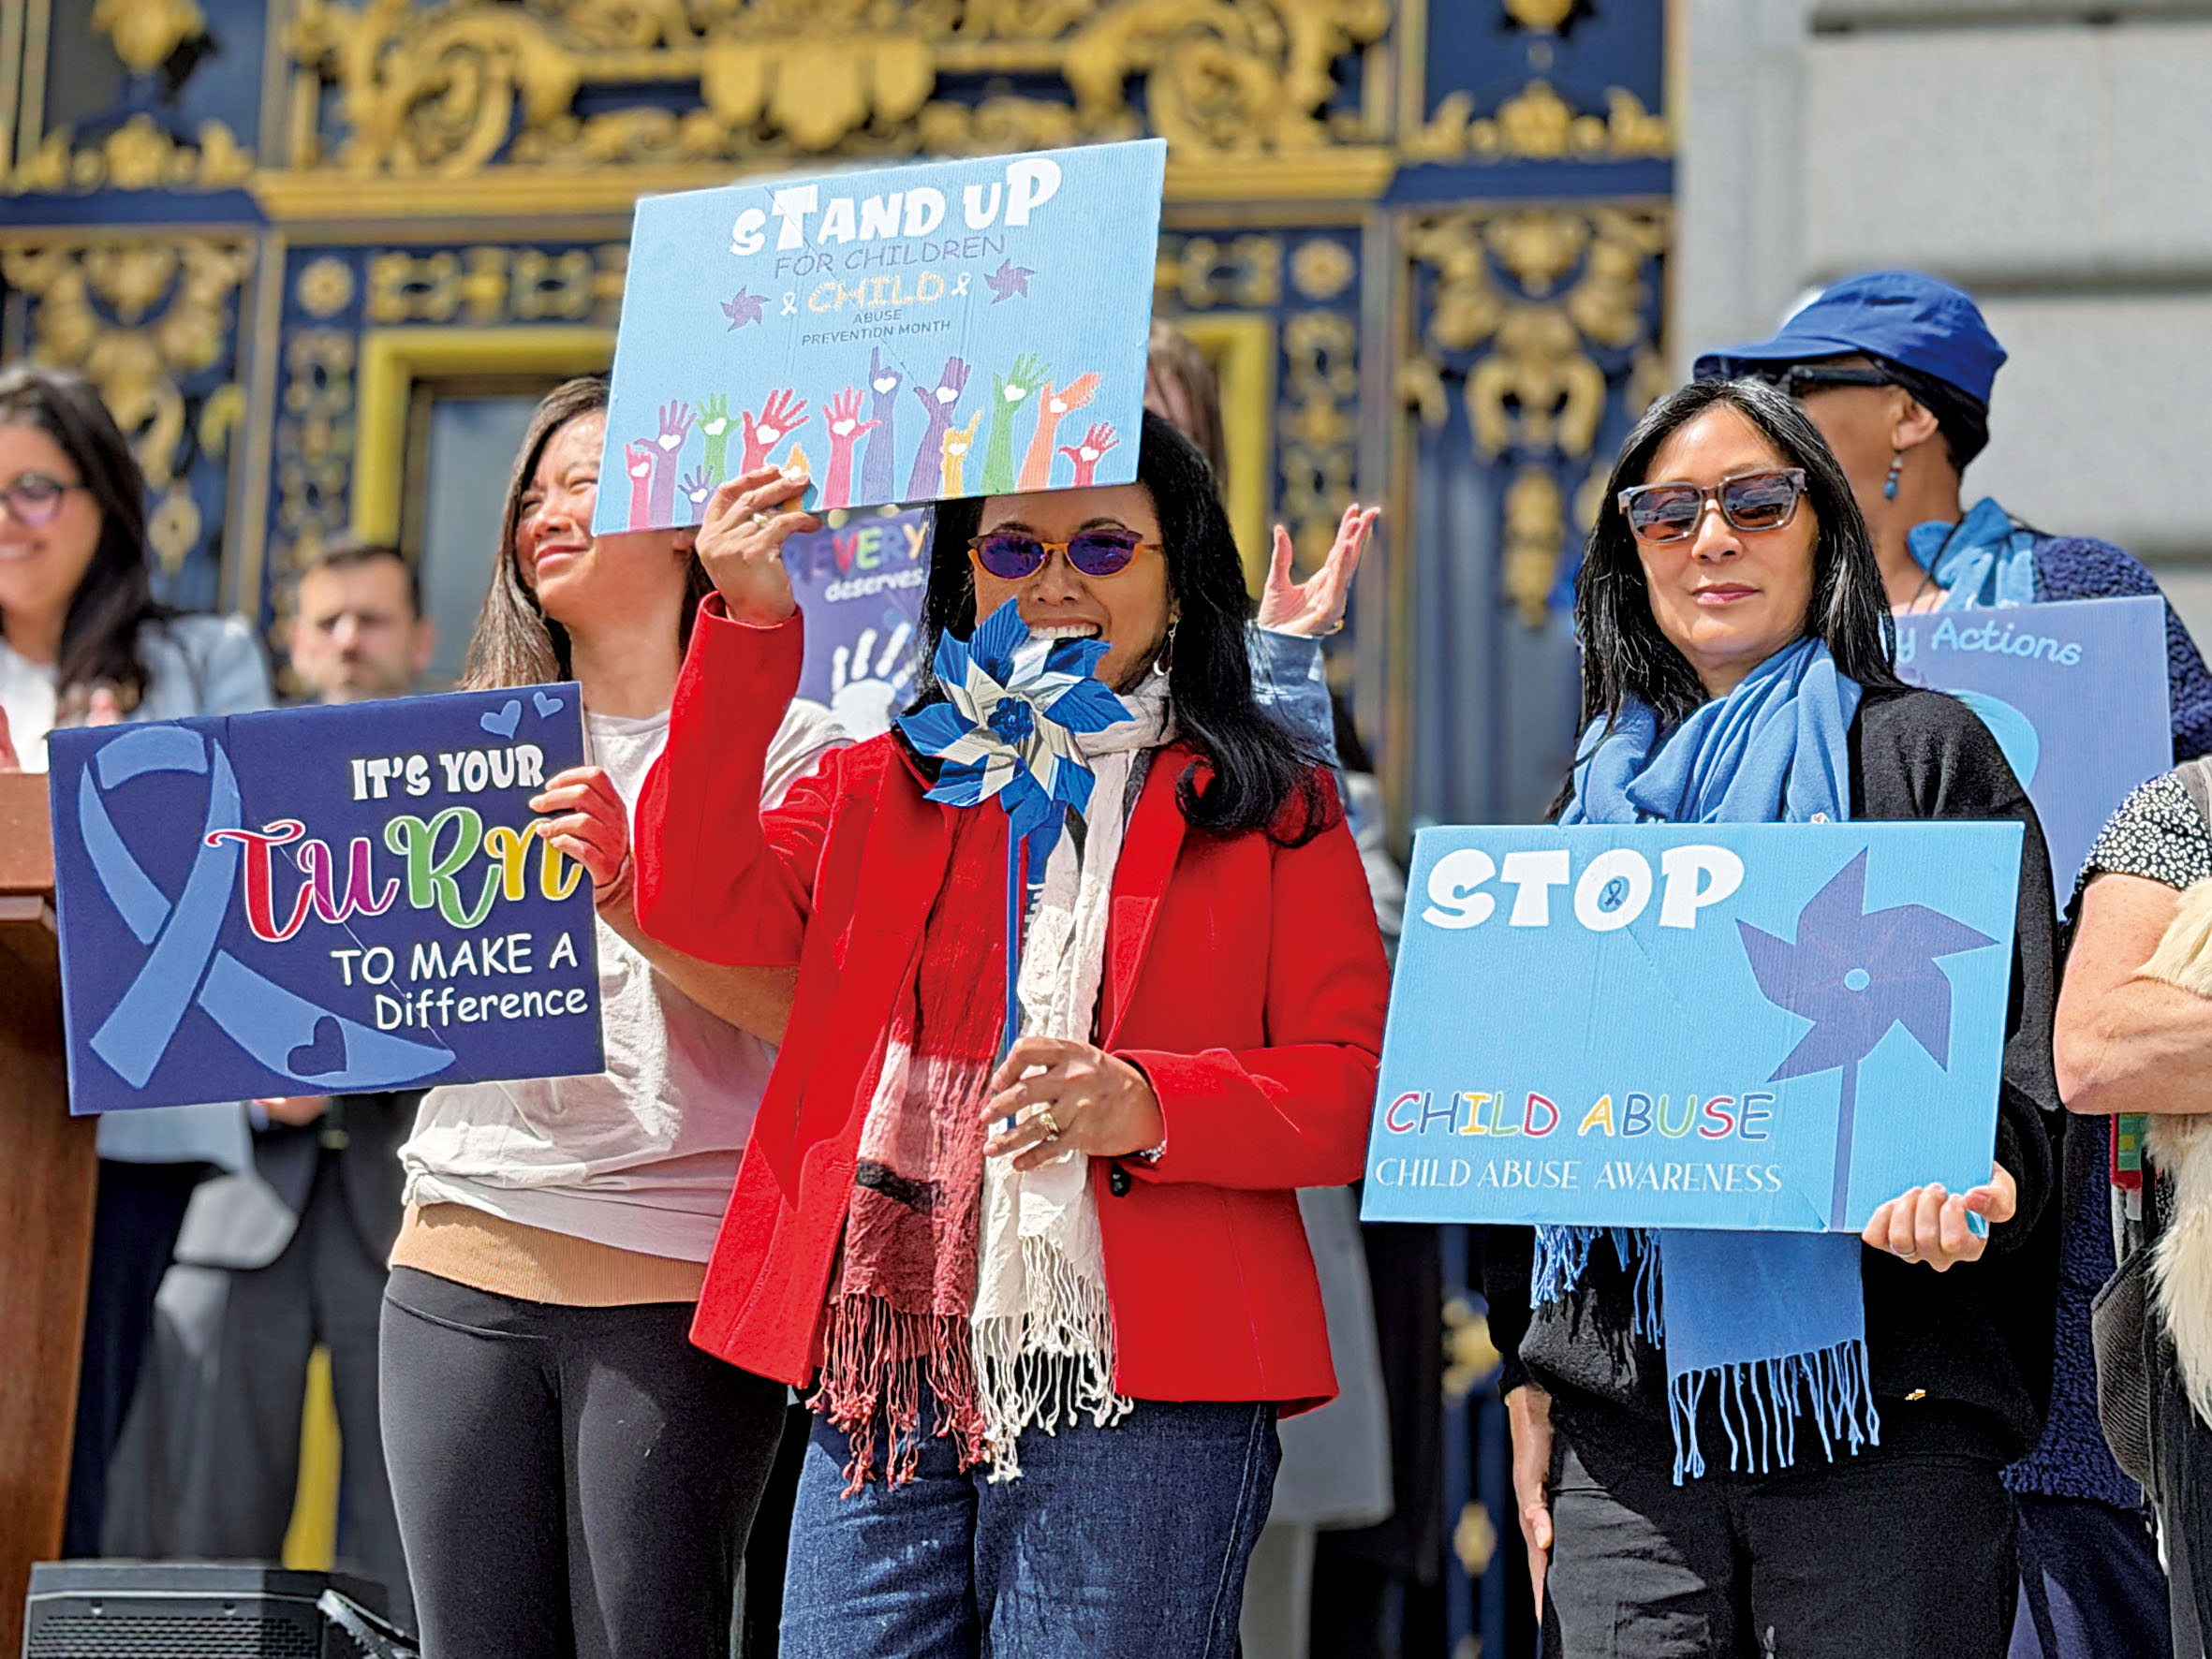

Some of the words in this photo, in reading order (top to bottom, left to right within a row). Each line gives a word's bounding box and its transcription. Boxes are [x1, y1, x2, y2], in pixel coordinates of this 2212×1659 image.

[730, 184, 946, 257] STAND
[963, 157, 1062, 230] UP
[774, 253, 833, 279] FOR
[845, 234, 1006, 270] CHILDREN
[808, 271, 945, 313] CHILD
[802, 327, 893, 345] PREVENTION
[898, 319, 951, 335] MONTH
[853, 309, 903, 324] ABUSE
[824, 566, 924, 602] deserves
[1930, 617, 2083, 666] Actions
[350, 756, 431, 800] IT'S
[439, 744, 546, 793] YOUR
[1421, 844, 1745, 932] STOP
[331, 945, 394, 986] TO
[410, 932, 532, 983] MAKE
[549, 932, 579, 970] A
[376, 988, 588, 1030] Difference
[1385, 1090, 1559, 1138] CHILD
[1578, 1091, 1777, 1141] ABUSE
[1375, 1157, 1471, 1188] CHILD
[1478, 1159, 1583, 1191] ABUSE
[1594, 1161, 1782, 1194] AWARENESS
